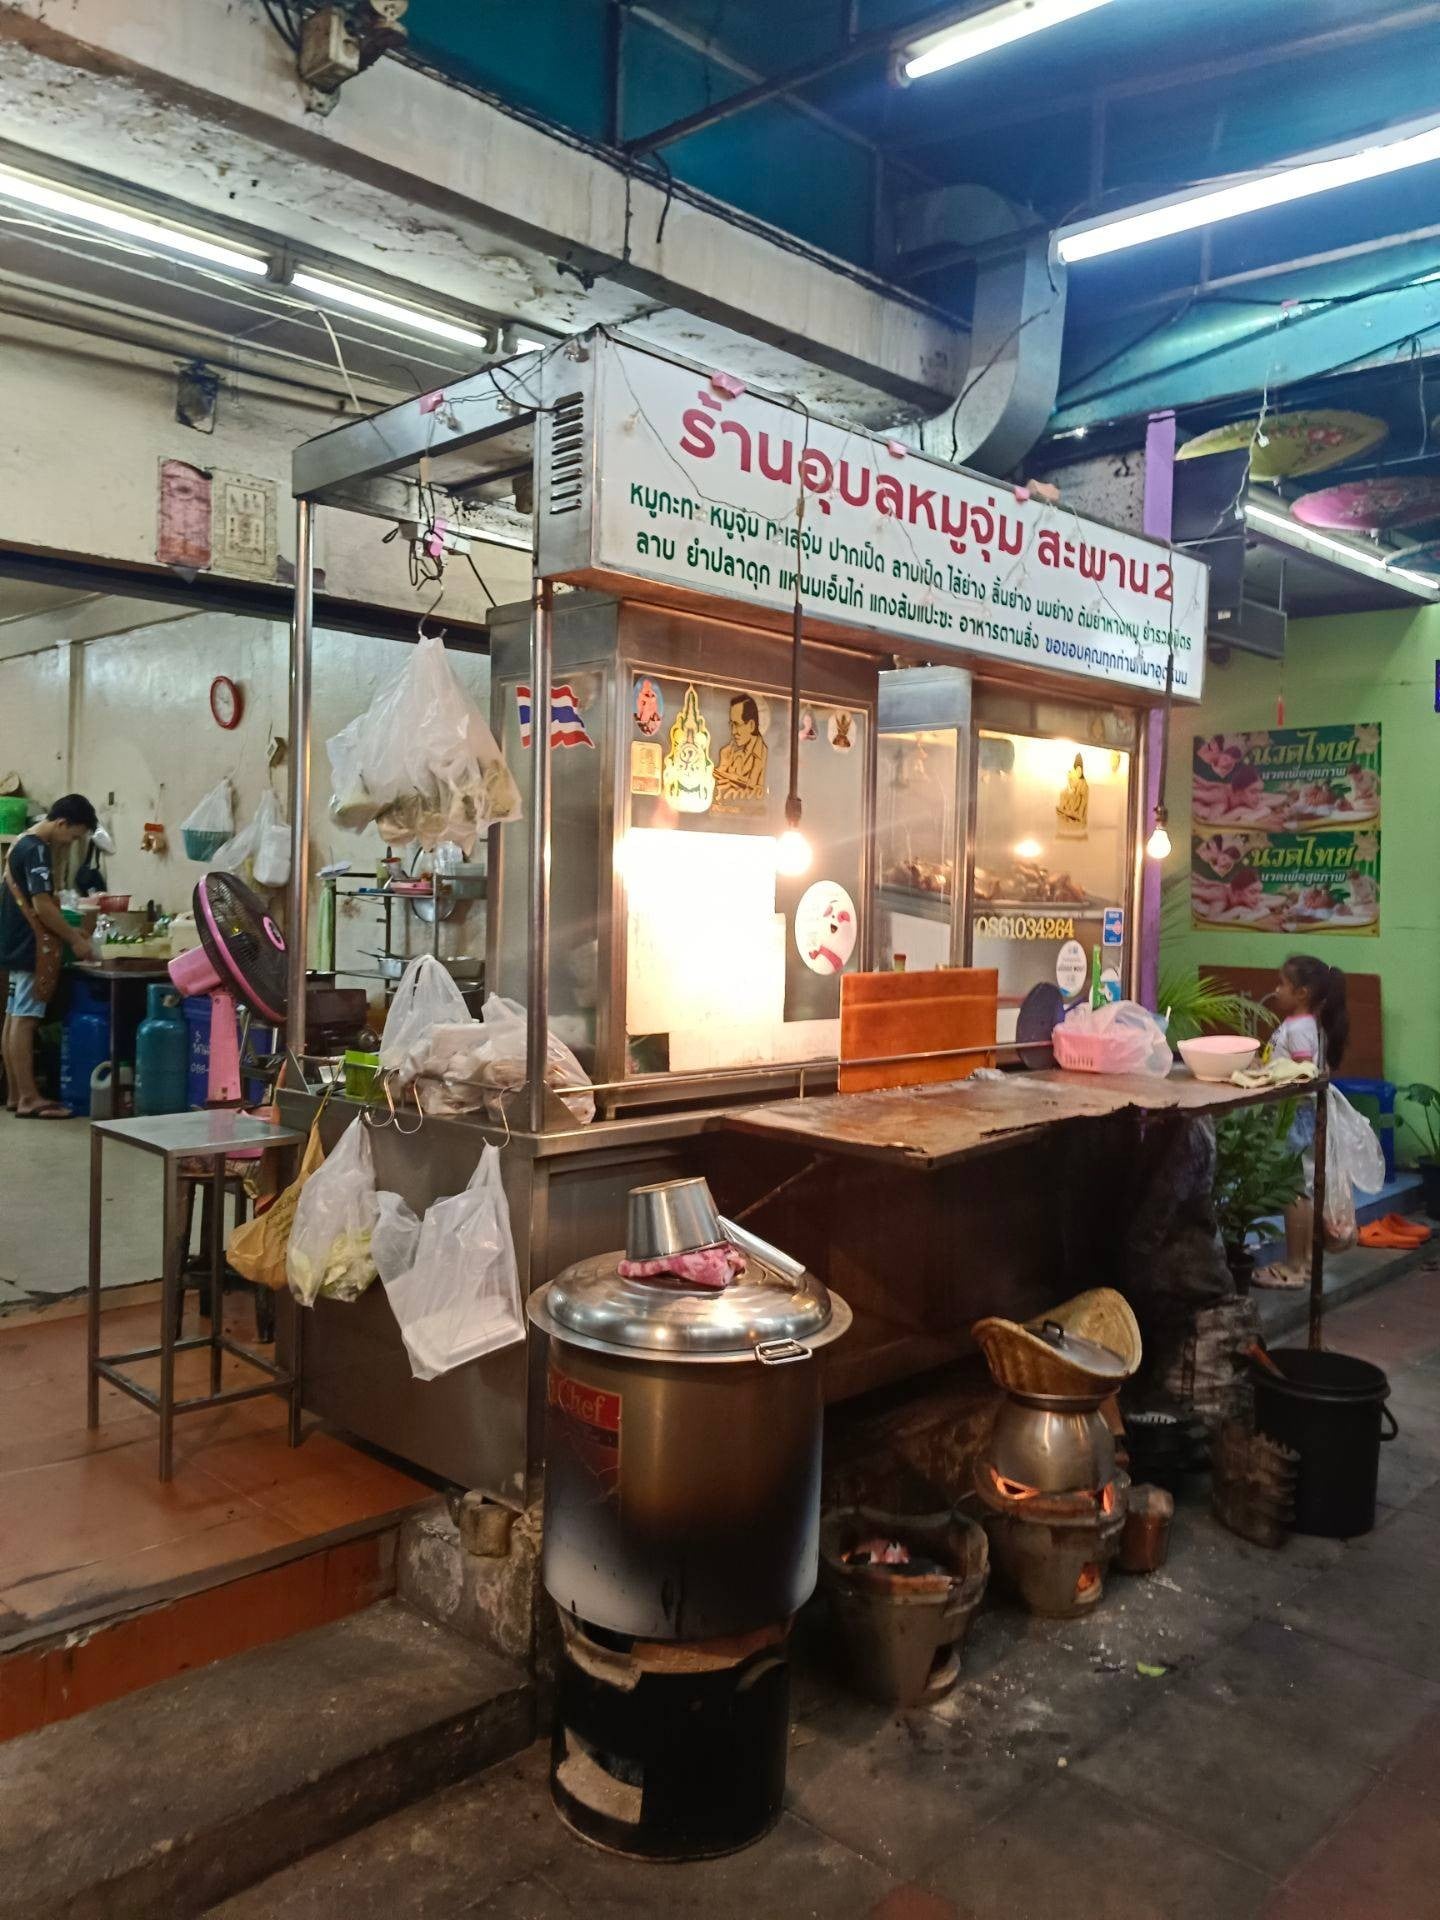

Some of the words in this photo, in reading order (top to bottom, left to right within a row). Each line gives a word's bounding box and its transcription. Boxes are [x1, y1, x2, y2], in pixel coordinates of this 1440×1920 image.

[636, 531, 675, 561] ลาบ
[686, 537, 771, 591] ยำปลาดุก
[959, 615, 1040, 650] อาหารตามสั่ง
[829, 537, 885, 574] ปากเป็ด
[948, 564, 986, 600] ไส้ย่าง
